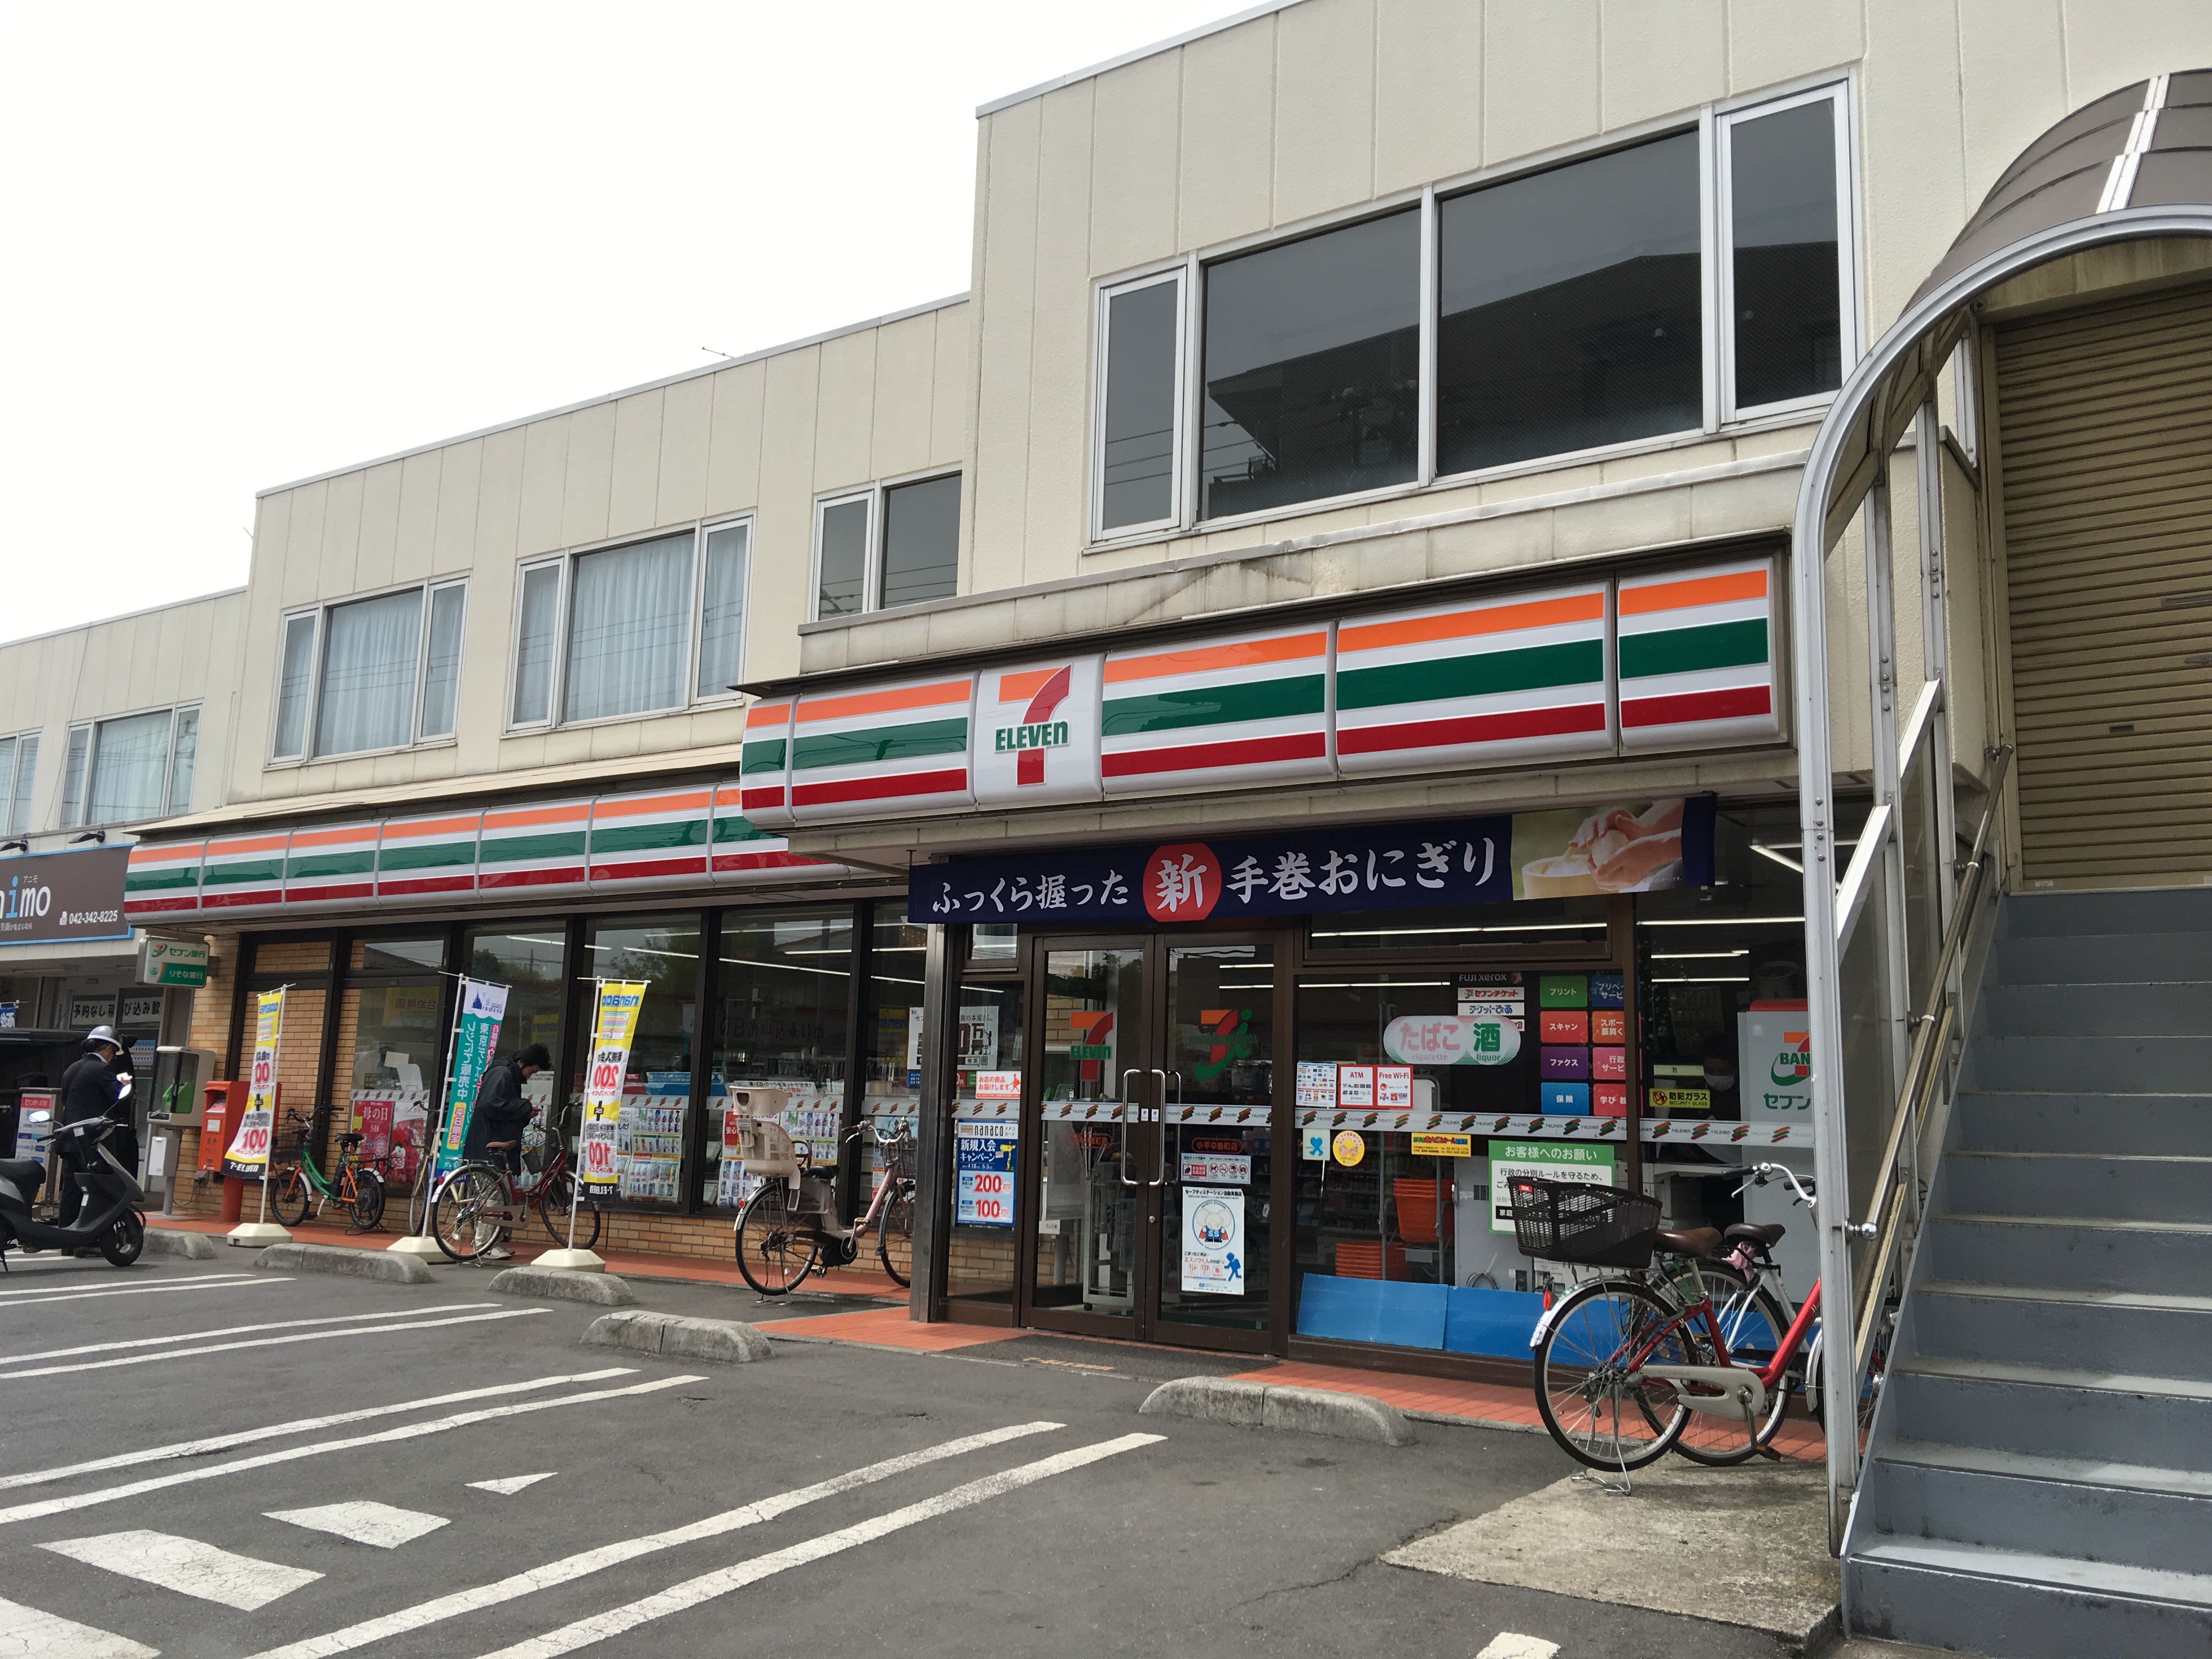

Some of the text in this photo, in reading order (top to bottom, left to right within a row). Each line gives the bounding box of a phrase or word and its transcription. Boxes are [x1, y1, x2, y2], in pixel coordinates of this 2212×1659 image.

[23, 874, 38, 884] アニモ
[932, 837, 1495, 913] ふっくら握った 新 手巻おにぎり
[69, 910, 119, 924] 042-342-8225
[170, 947, 206, 958] セブン銀行
[169, 970, 203, 979] りそな銀行
[1475, 990, 1519, 998] セブンチケット
[1469, 1005, 1513, 1014] チケットぴあ
[1400, 1022, 1501, 1052] たばこ 酒
[1412, 1053, 1502, 1062] cigarette liquor
[1556, 1094, 1573, 1103] 保険
[1600, 1096, 1616, 1104] 学び
[1669, 1092, 1708, 1101] 防犯ガラス
[363, 1106, 388, 1121] 母の日
[974, 1125, 1003, 1137] nanaco
[241, 1128, 268, 1150] 100
[960, 1138, 996, 1152] 新規入会
[960, 1152, 995, 1163] キャンペーン
[1505, 1146, 1598, 1161] お客様へのお願い
[1500, 1167, 1602, 1181] 行政の分別ルールを守るため、
[973, 1173, 1002, 1193] 200
[975, 1199, 1001, 1218] 100
